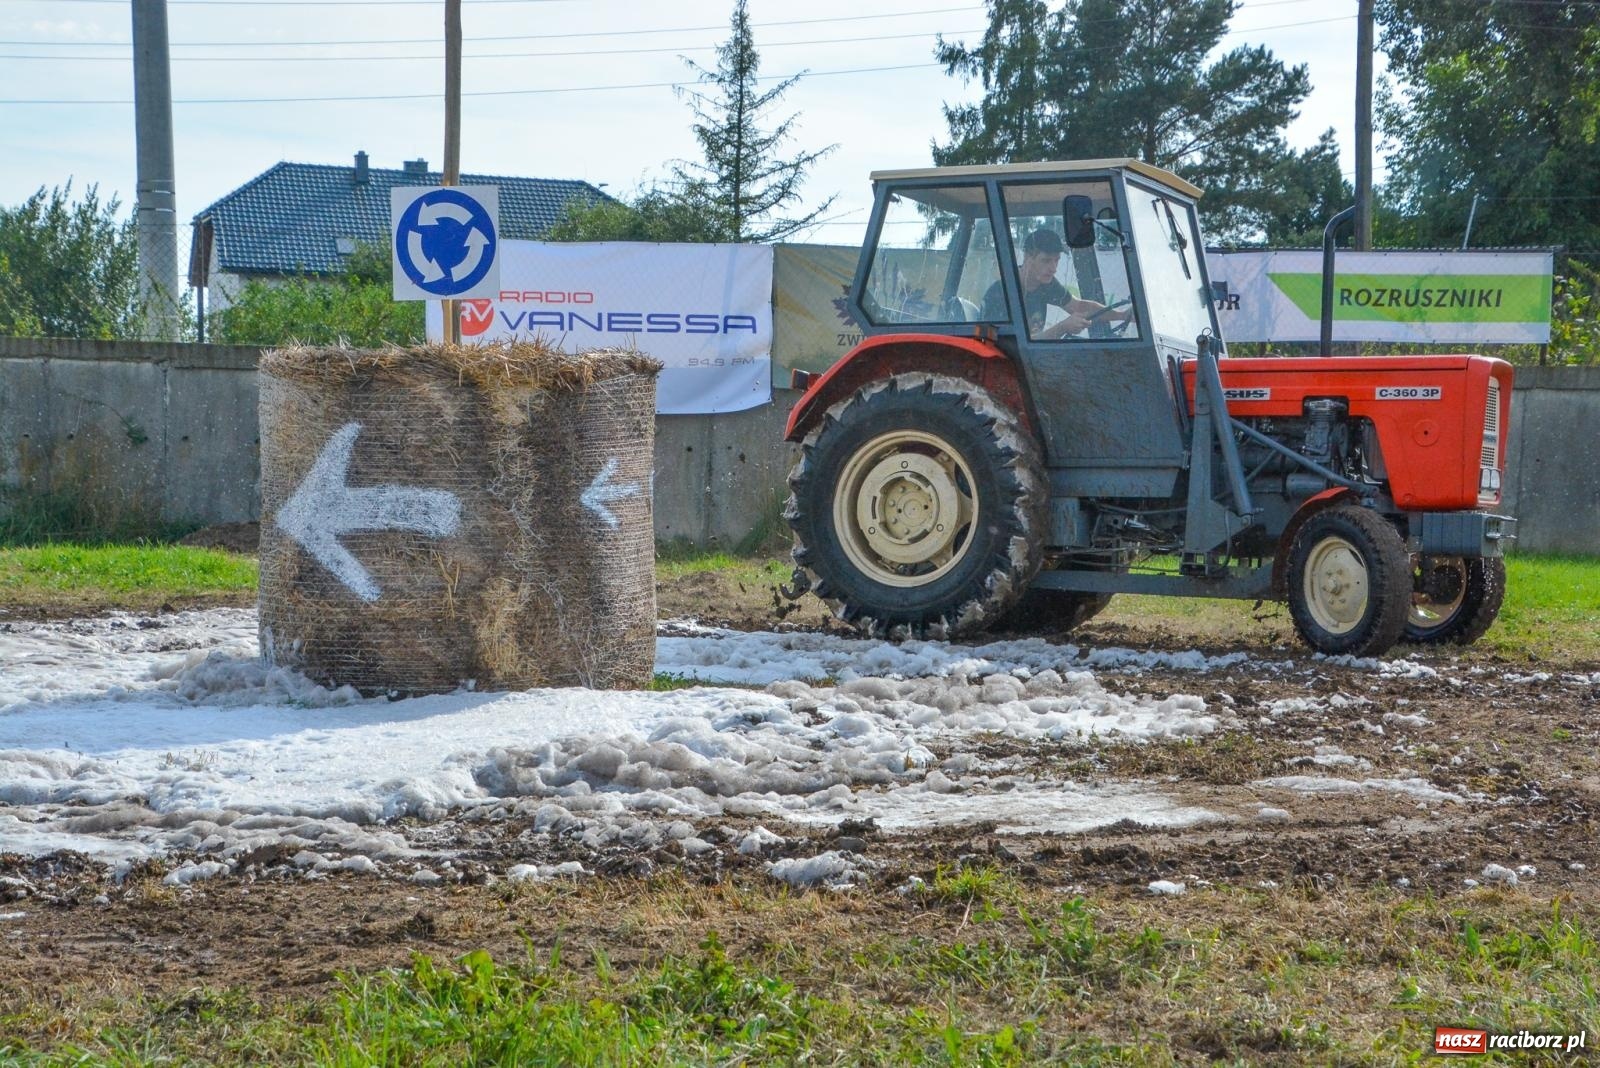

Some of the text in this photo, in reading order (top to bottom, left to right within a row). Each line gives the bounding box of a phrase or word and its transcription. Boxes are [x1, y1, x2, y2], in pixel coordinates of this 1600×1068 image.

[499, 291, 593, 304] RADIO
[1339, 287, 1502, 308] ROZRUSZNIKI
[500, 311, 757, 334] VANESSA
[837, 334, 865, 346] ZW
[688, 357, 755, 367] 94.9 FM
[1379, 388, 1440, 397] C-360 3P
